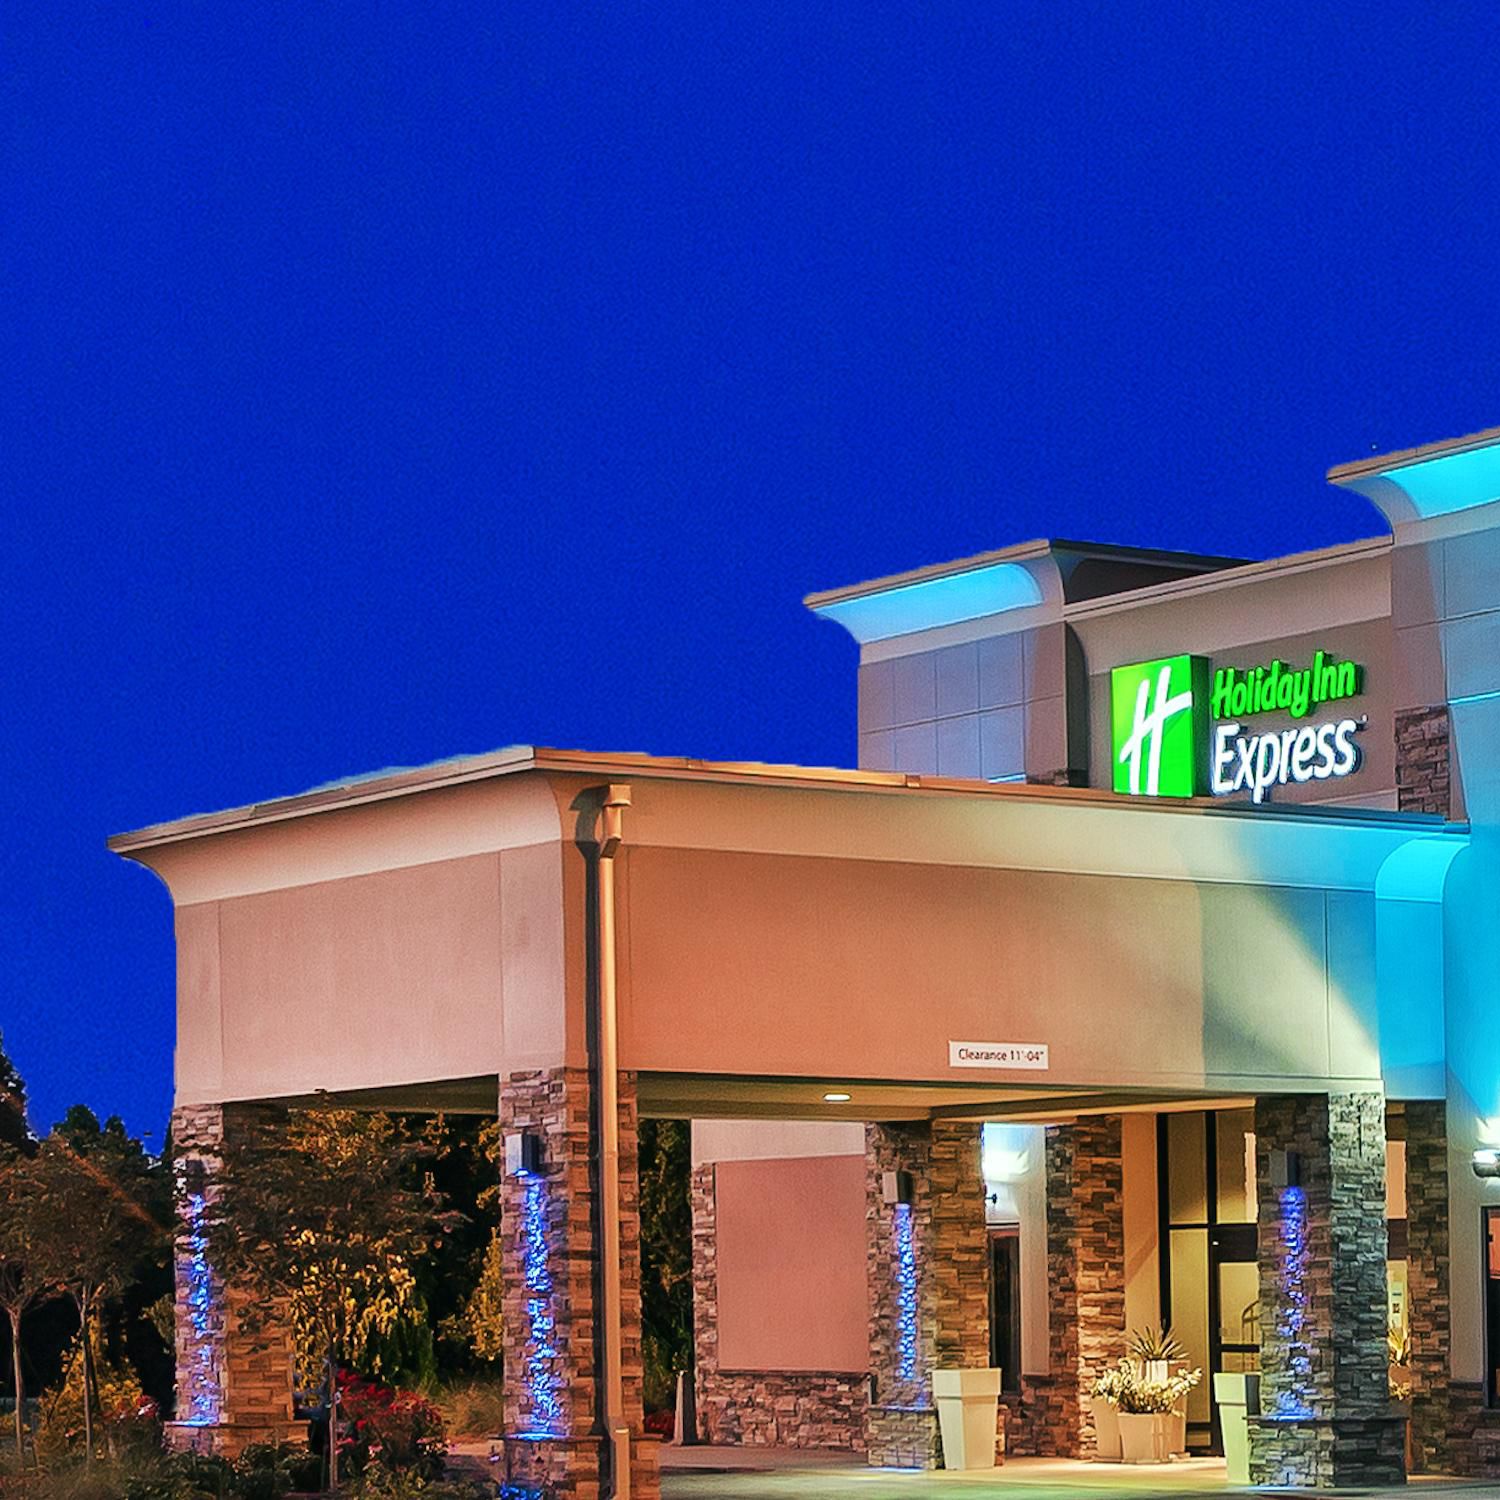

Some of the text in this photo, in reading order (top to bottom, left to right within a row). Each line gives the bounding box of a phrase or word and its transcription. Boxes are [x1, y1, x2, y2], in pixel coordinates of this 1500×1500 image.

[1211, 650, 1357, 719] Holiday Inn
[1212, 719, 1358, 804] Express
[958, 1048, 1007, 1061] Clearance
